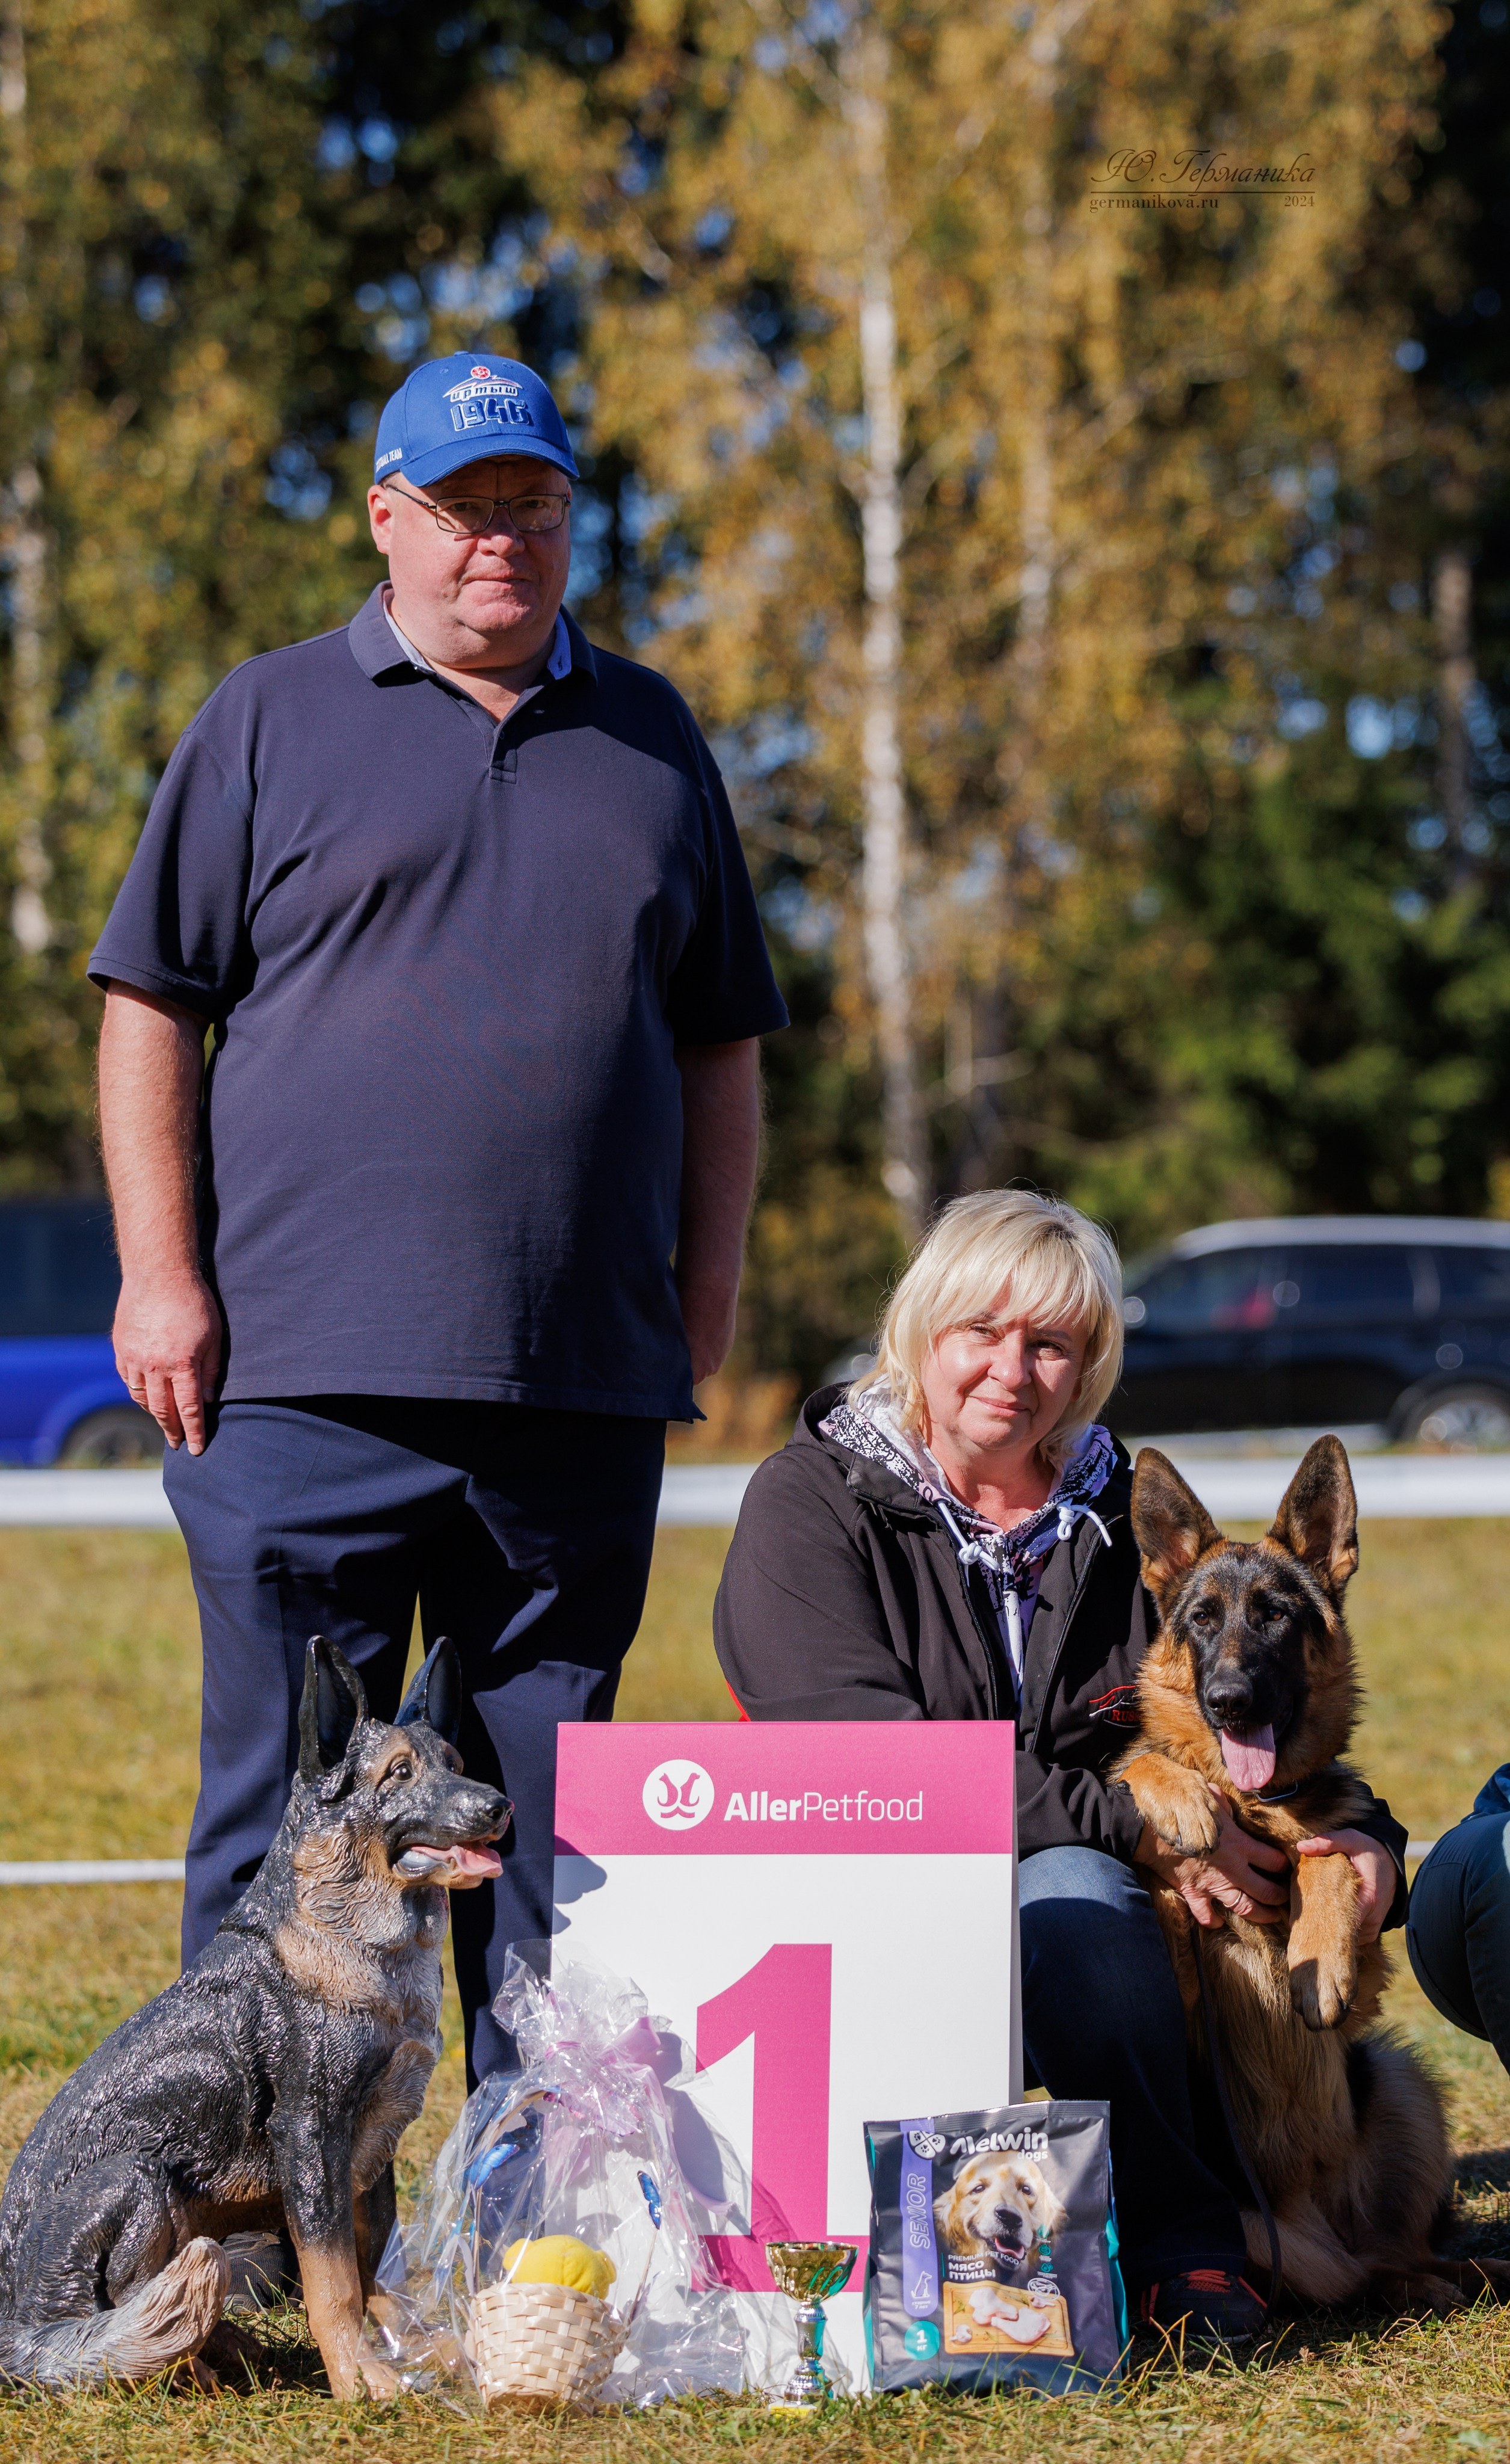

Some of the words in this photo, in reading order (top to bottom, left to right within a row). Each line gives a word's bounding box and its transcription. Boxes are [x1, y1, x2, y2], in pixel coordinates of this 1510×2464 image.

[451, 398, 529, 431] 1946
[389, 448, 402, 462] TEAM
[724, 1790, 923, 1821] AllerPetfood
[690, 1943, 870, 2293] 1
[1017, 2149, 1048, 2161] dogs
[907, 2173, 931, 2249] SENIOR
[948, 2252, 984, 2261] PREMIUM
[1000, 2253, 1019, 2265] FOOD
[917, 2329, 928, 2343] 1
